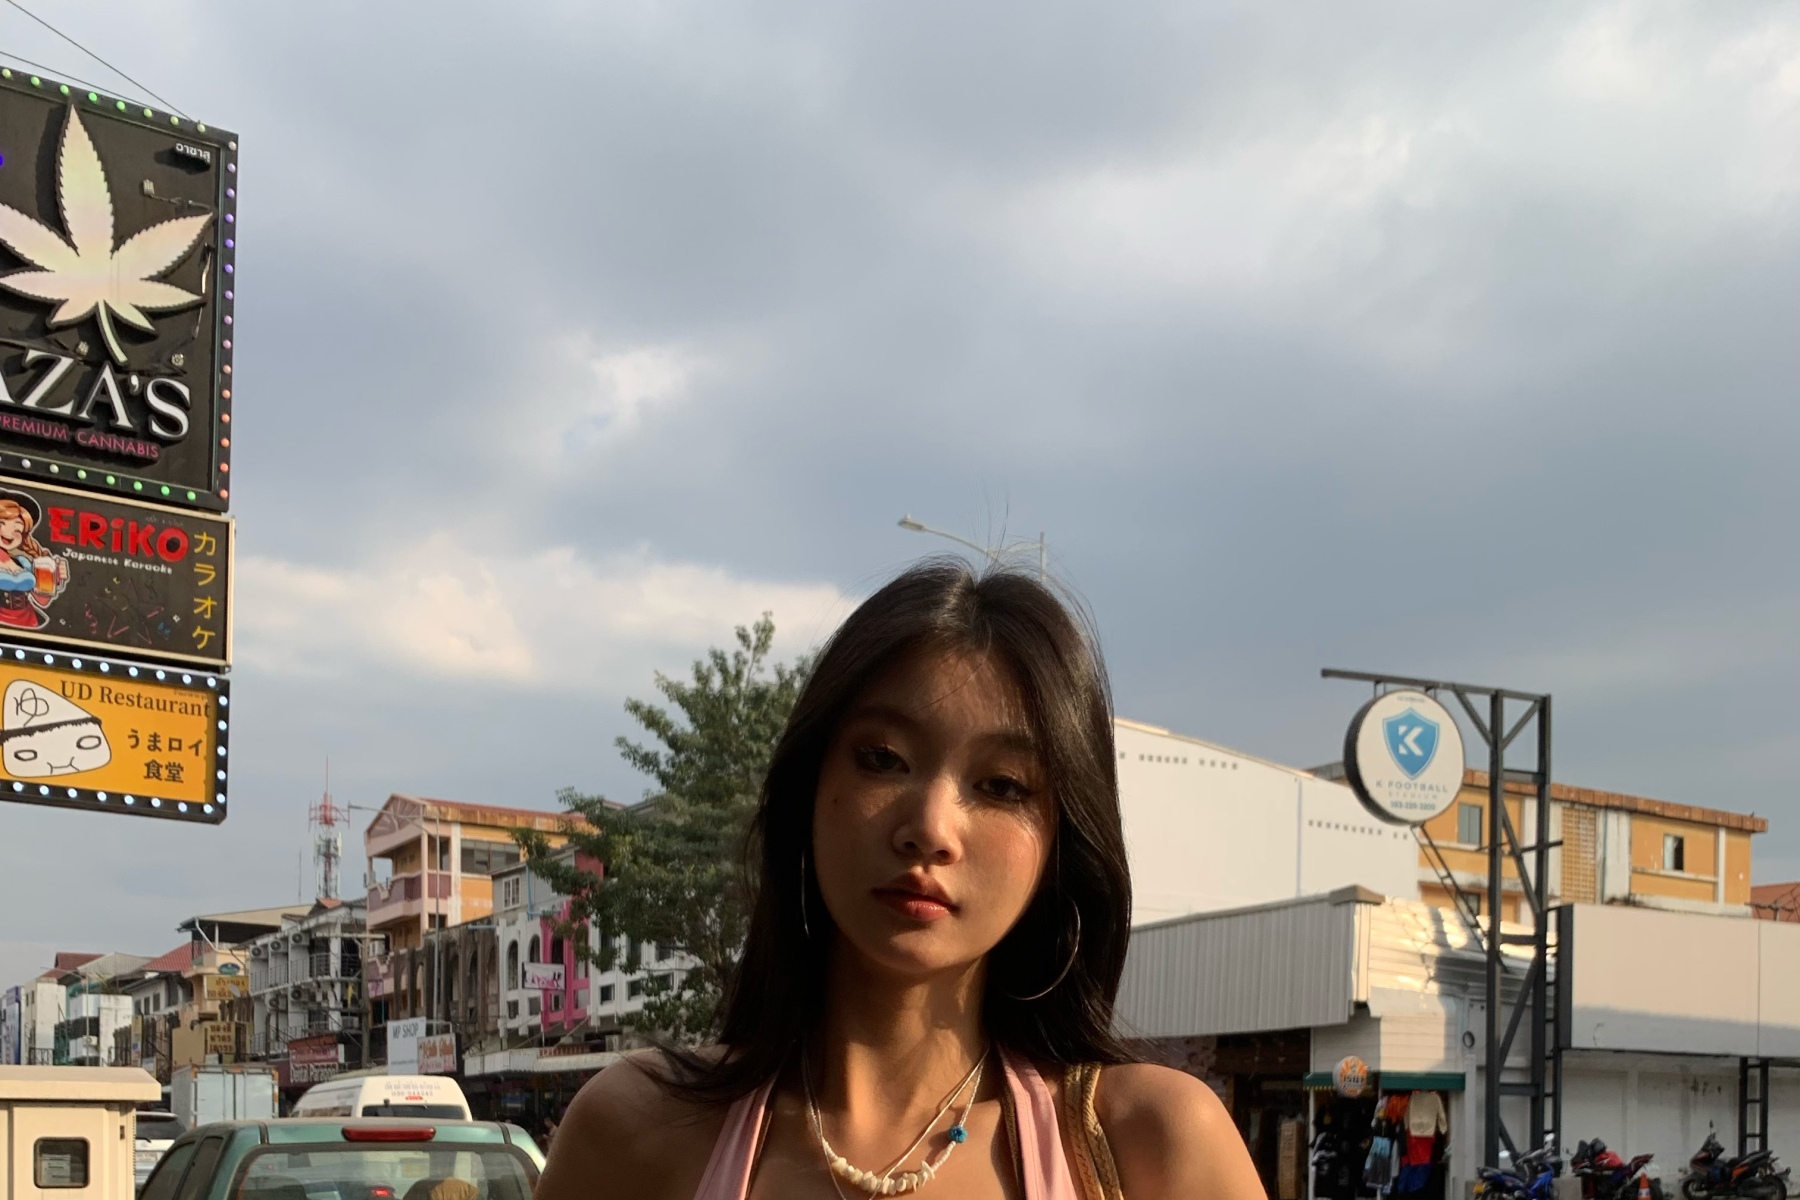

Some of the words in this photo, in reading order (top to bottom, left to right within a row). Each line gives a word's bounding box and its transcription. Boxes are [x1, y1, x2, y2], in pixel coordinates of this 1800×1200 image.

[0, 350, 191, 438] ZA'S
[0, 415, 67, 440] REMIUM
[77, 431, 158, 458] CANNABIS
[62, 548, 118, 566] Japanese
[124, 559, 172, 575] Karaoke
[192, 531, 217, 649] カラオケ
[60, 680, 92, 701] UD
[99, 685, 212, 718] Restaurant
[143, 759, 184, 783] 食堂
[1376, 780, 1383, 788] K
[1387, 781, 1448, 794] FOOTBALL
[402, 1022, 419, 1038] SHOP
